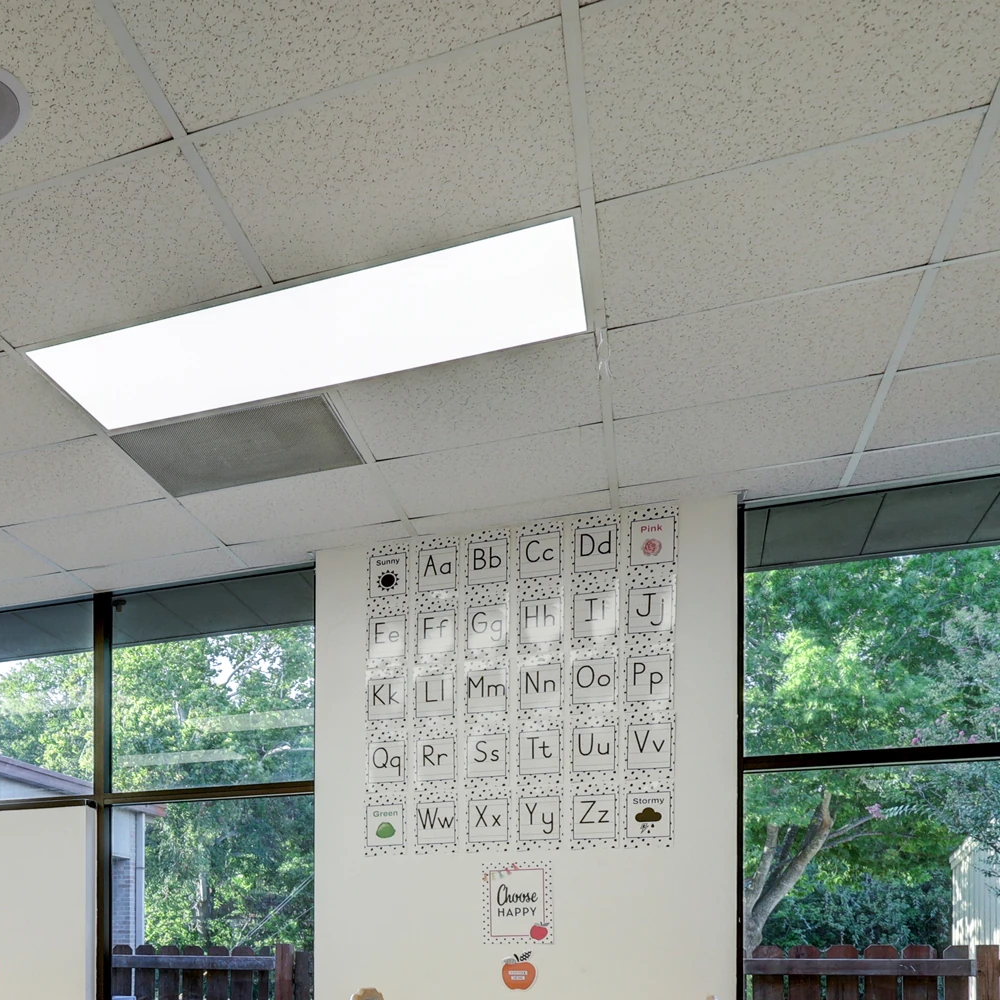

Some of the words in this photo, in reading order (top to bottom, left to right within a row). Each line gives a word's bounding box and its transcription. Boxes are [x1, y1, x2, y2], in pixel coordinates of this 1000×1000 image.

[640, 523, 663, 533] Pink
[525, 540, 554, 563] Cc
[580, 531, 612, 557] Dd
[376, 557, 400, 567] Sunny
[423, 555, 452, 577] Aa
[472, 548, 502, 571] Bb
[524, 604, 556, 629] Hh
[584, 598, 605, 622] Ii
[636, 593, 665, 626] Jj
[374, 622, 400, 644] Ee
[423, 617, 449, 639] Ff
[471, 611, 503, 641] Gg
[468, 676, 505, 698] Mm
[525, 671, 556, 694] Nn
[576, 666, 611, 688] Oo
[632, 662, 664, 694] Pp
[372, 684, 400, 706] Kk
[425, 680, 445, 702] Ll
[474, 741, 500, 763] Ss
[527, 737, 553, 759] Tt
[578, 733, 610, 756] Uu
[634, 730, 665, 753] Vv
[372, 747, 401, 777] Qq
[423, 745, 448, 767] Rr
[580, 800, 609, 824] Zz
[632, 797, 665, 806] Stormy
[373, 809, 398, 818] Green
[418, 807, 454, 830] Ww
[475, 805, 501, 827] Xx
[525, 803, 554, 834] Yy
[497, 883, 538, 906] Choose
[497, 907, 537, 917] HAPPY
